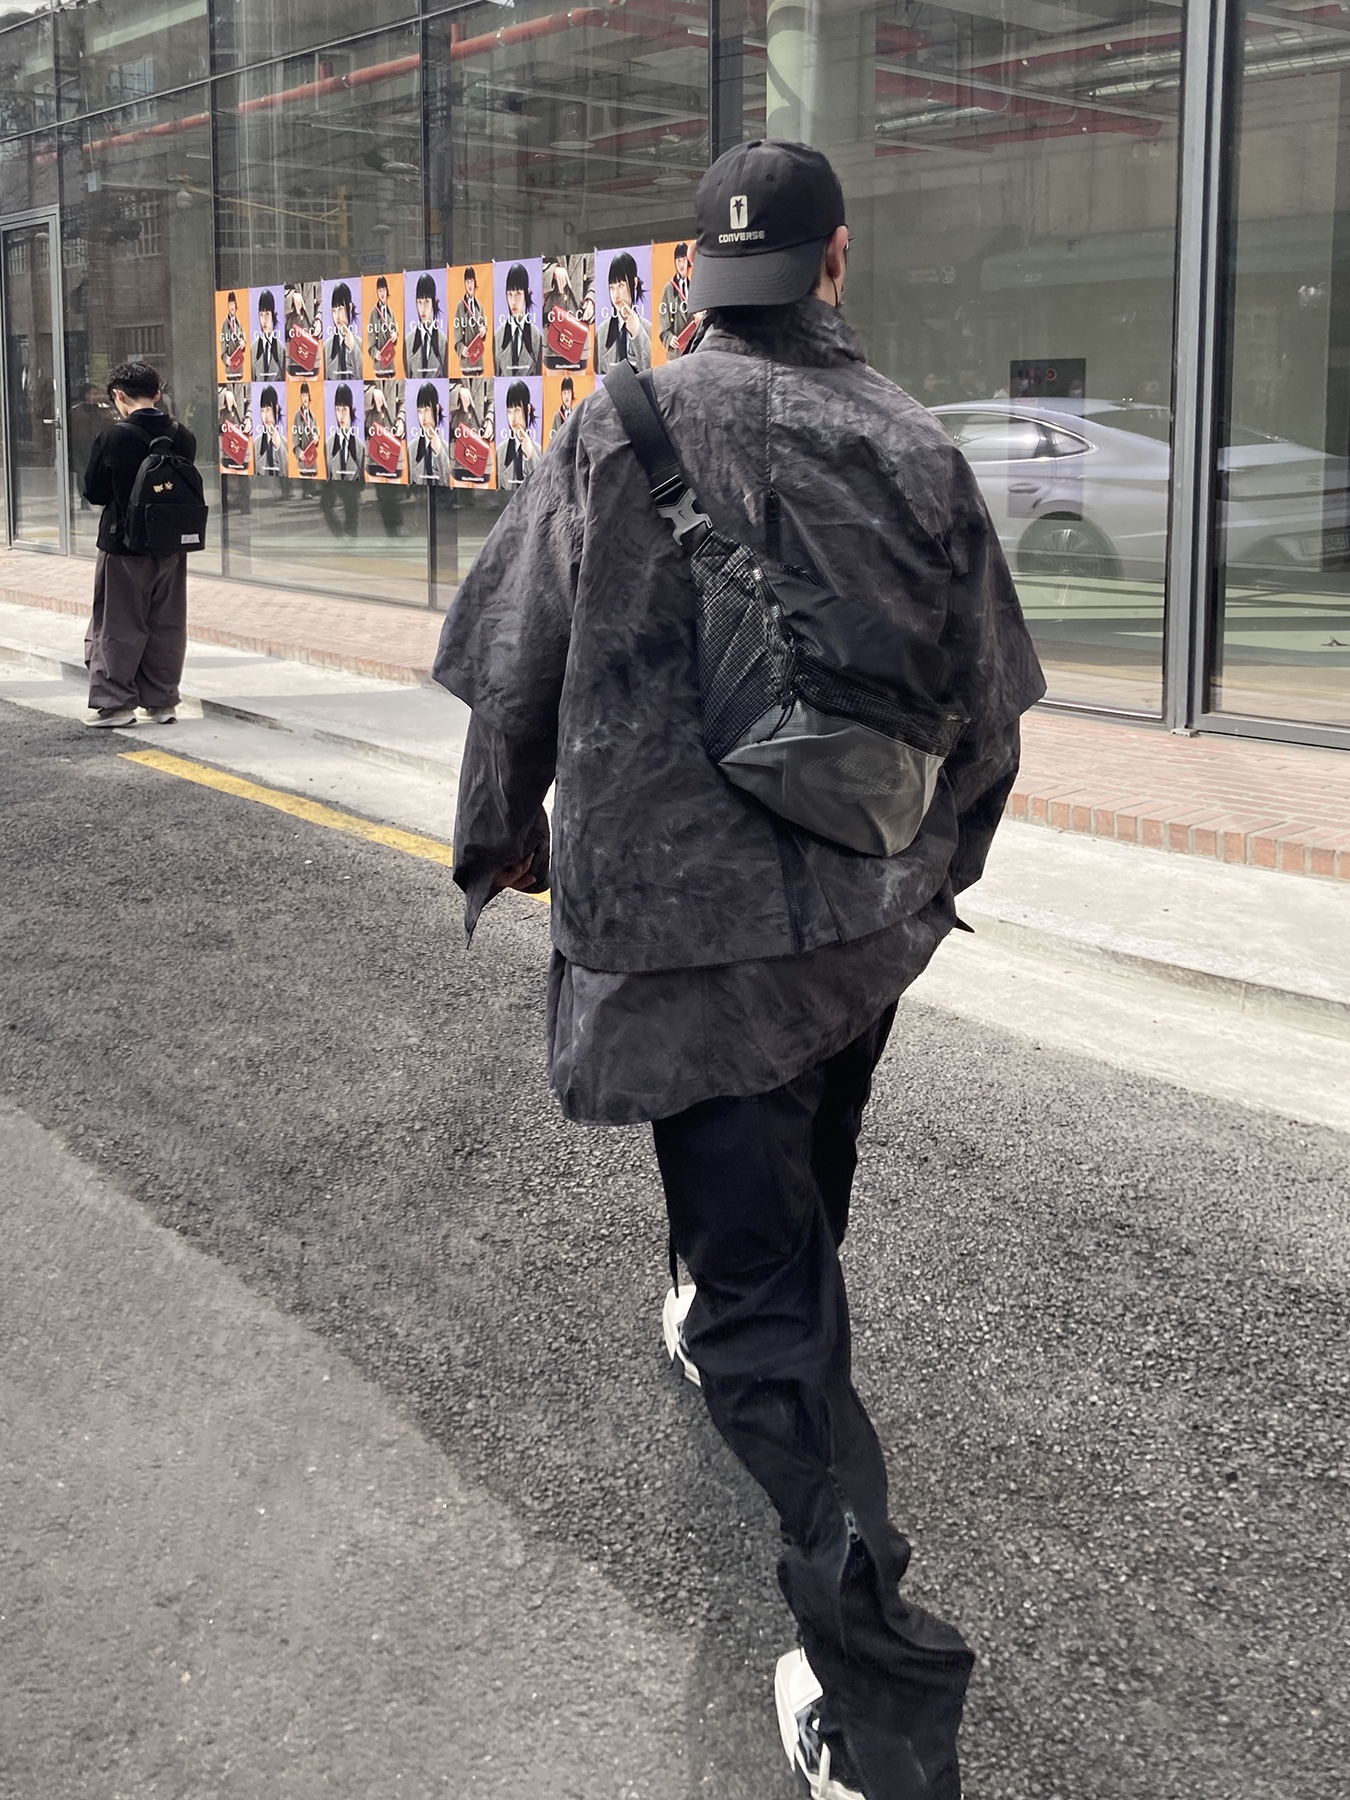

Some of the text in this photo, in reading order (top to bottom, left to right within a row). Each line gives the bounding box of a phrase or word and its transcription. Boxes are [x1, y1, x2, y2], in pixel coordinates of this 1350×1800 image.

[718, 230, 765, 243] CONVERSE
[547, 309, 588, 323] GUCC
[601, 304, 645, 319] GUCCI
[453, 316, 487, 329] GUCCI
[499, 312, 536, 325] GUCCI
[327, 325, 358, 336] GUCCI
[367, 322, 399, 334] GUCCI
[410, 319, 444, 331] GUCCI
[219, 331, 246, 342] GUCCI
[253, 329, 280, 341] GUCCI
[289, 327, 318, 339] GUCC
[221, 423, 248, 433] GUCC
[256, 424, 284, 435] GUCCI
[291, 424, 320, 435] GUCCI
[329, 425, 360, 436] GUCCI
[368, 426, 400, 437] GUCC
[411, 426, 444, 438] GUCCI
[454, 427, 487, 439] GUCC
[500, 428, 536, 440] GUCCI
